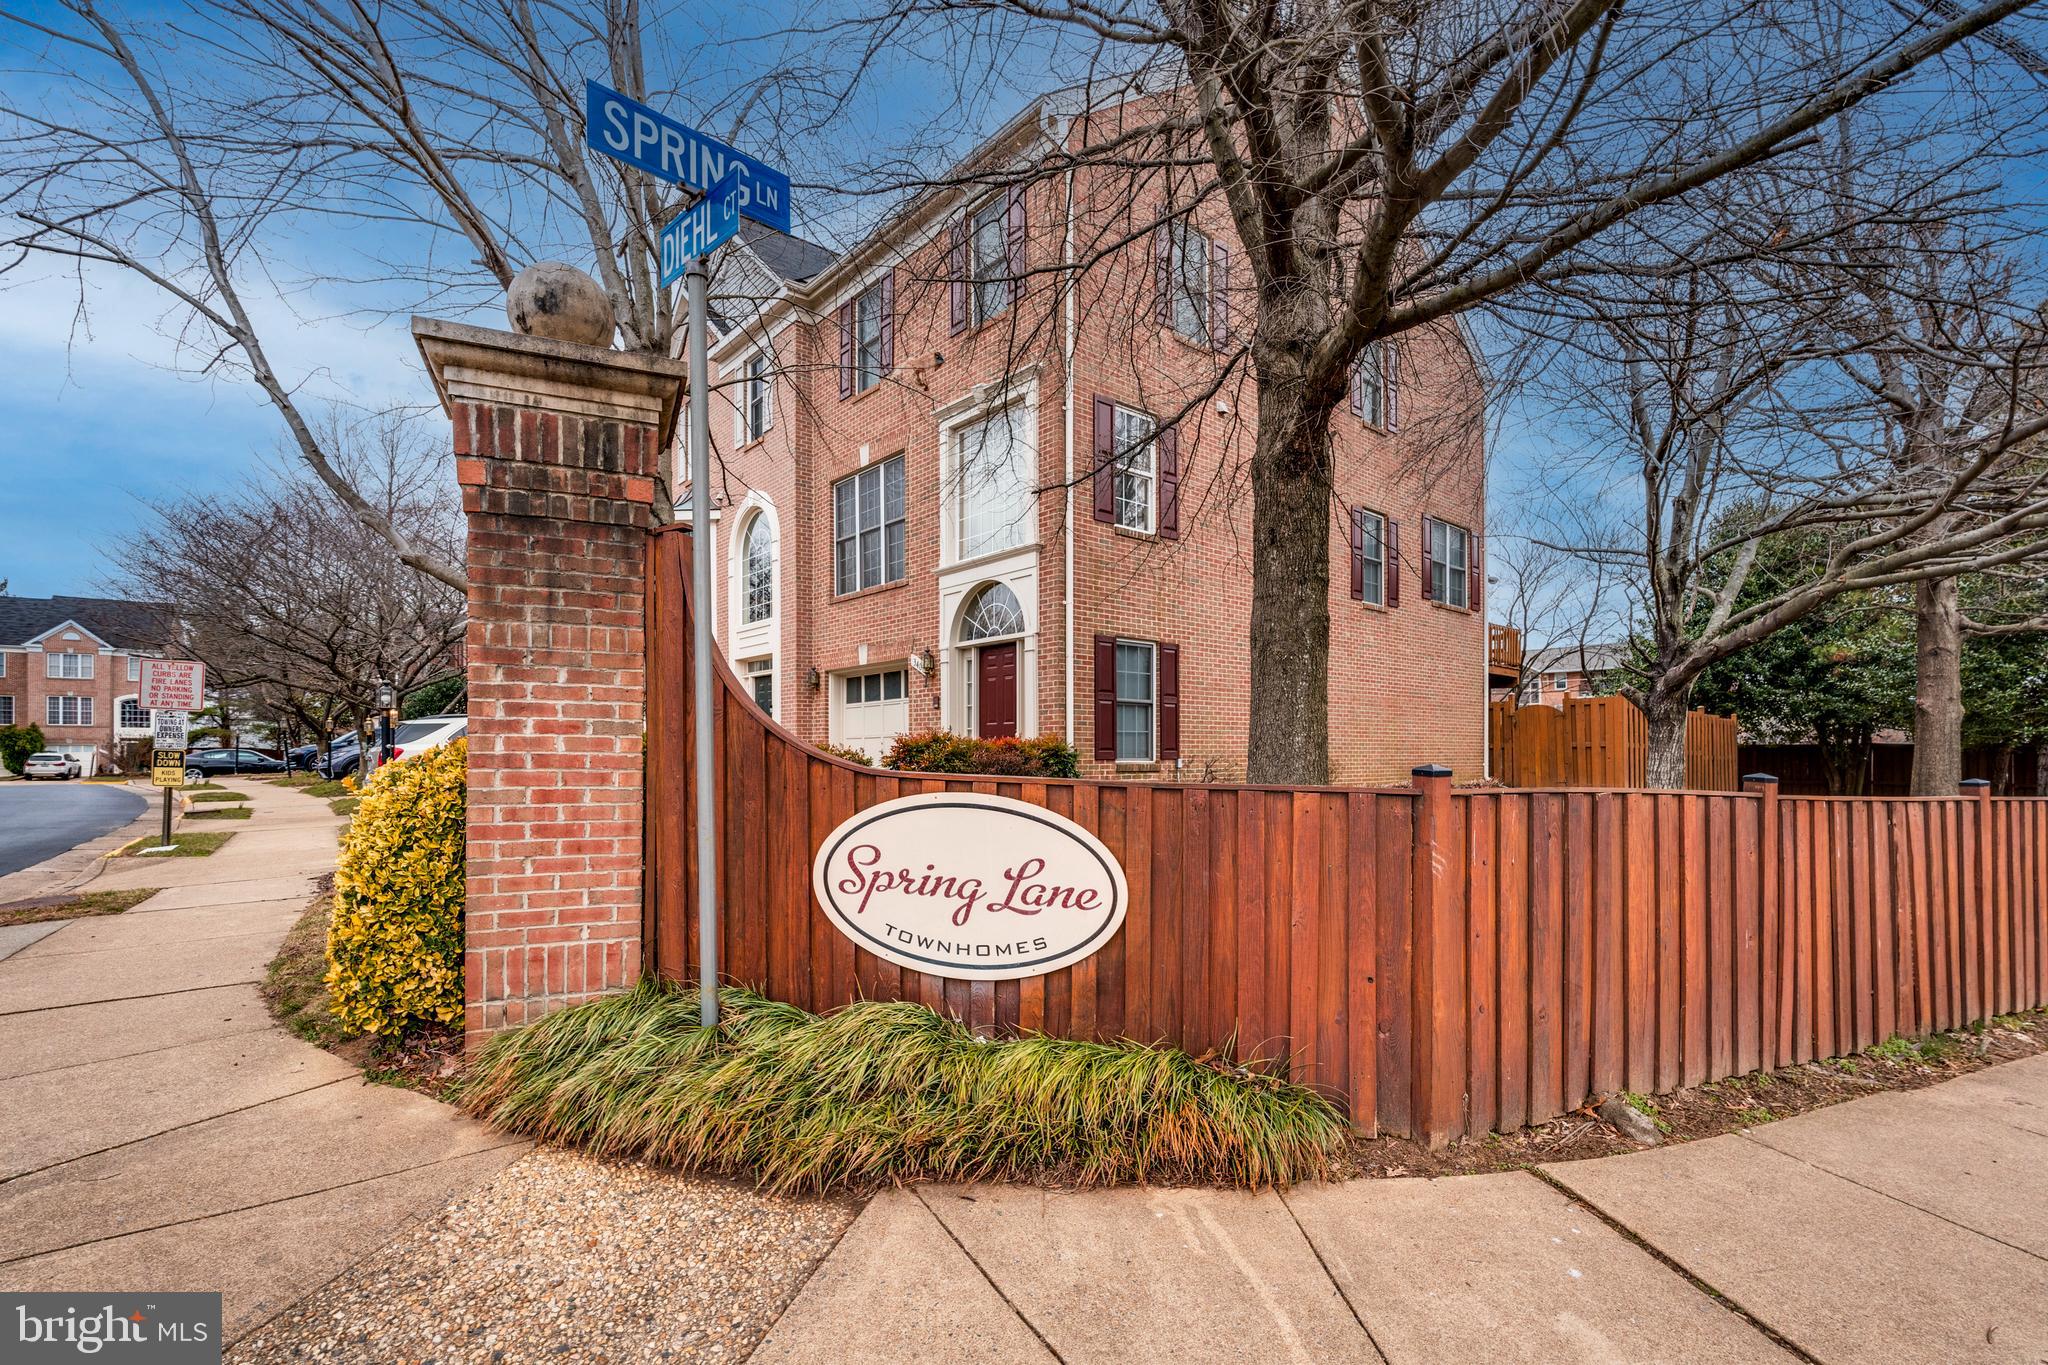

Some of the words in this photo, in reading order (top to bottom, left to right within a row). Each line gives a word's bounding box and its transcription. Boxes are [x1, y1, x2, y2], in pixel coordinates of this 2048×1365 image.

[603, 100, 750, 207] SPRING
[756, 180, 778, 211] LN
[663, 199, 718, 276] DIEHL
[723, 189, 737, 221] CT
[153, 670, 176, 678] CURBS
[152, 677, 167, 685] FIRE
[159, 725, 183, 733] OWNERS
[157, 731, 184, 739] EXPENSE
[157, 751, 180, 759] SLOW
[157, 759, 180, 767] DOWN
[838, 844, 987, 927] Spring
[986, 858, 1103, 916] Lane
[885, 923, 1048, 957] TOWNHOMES
